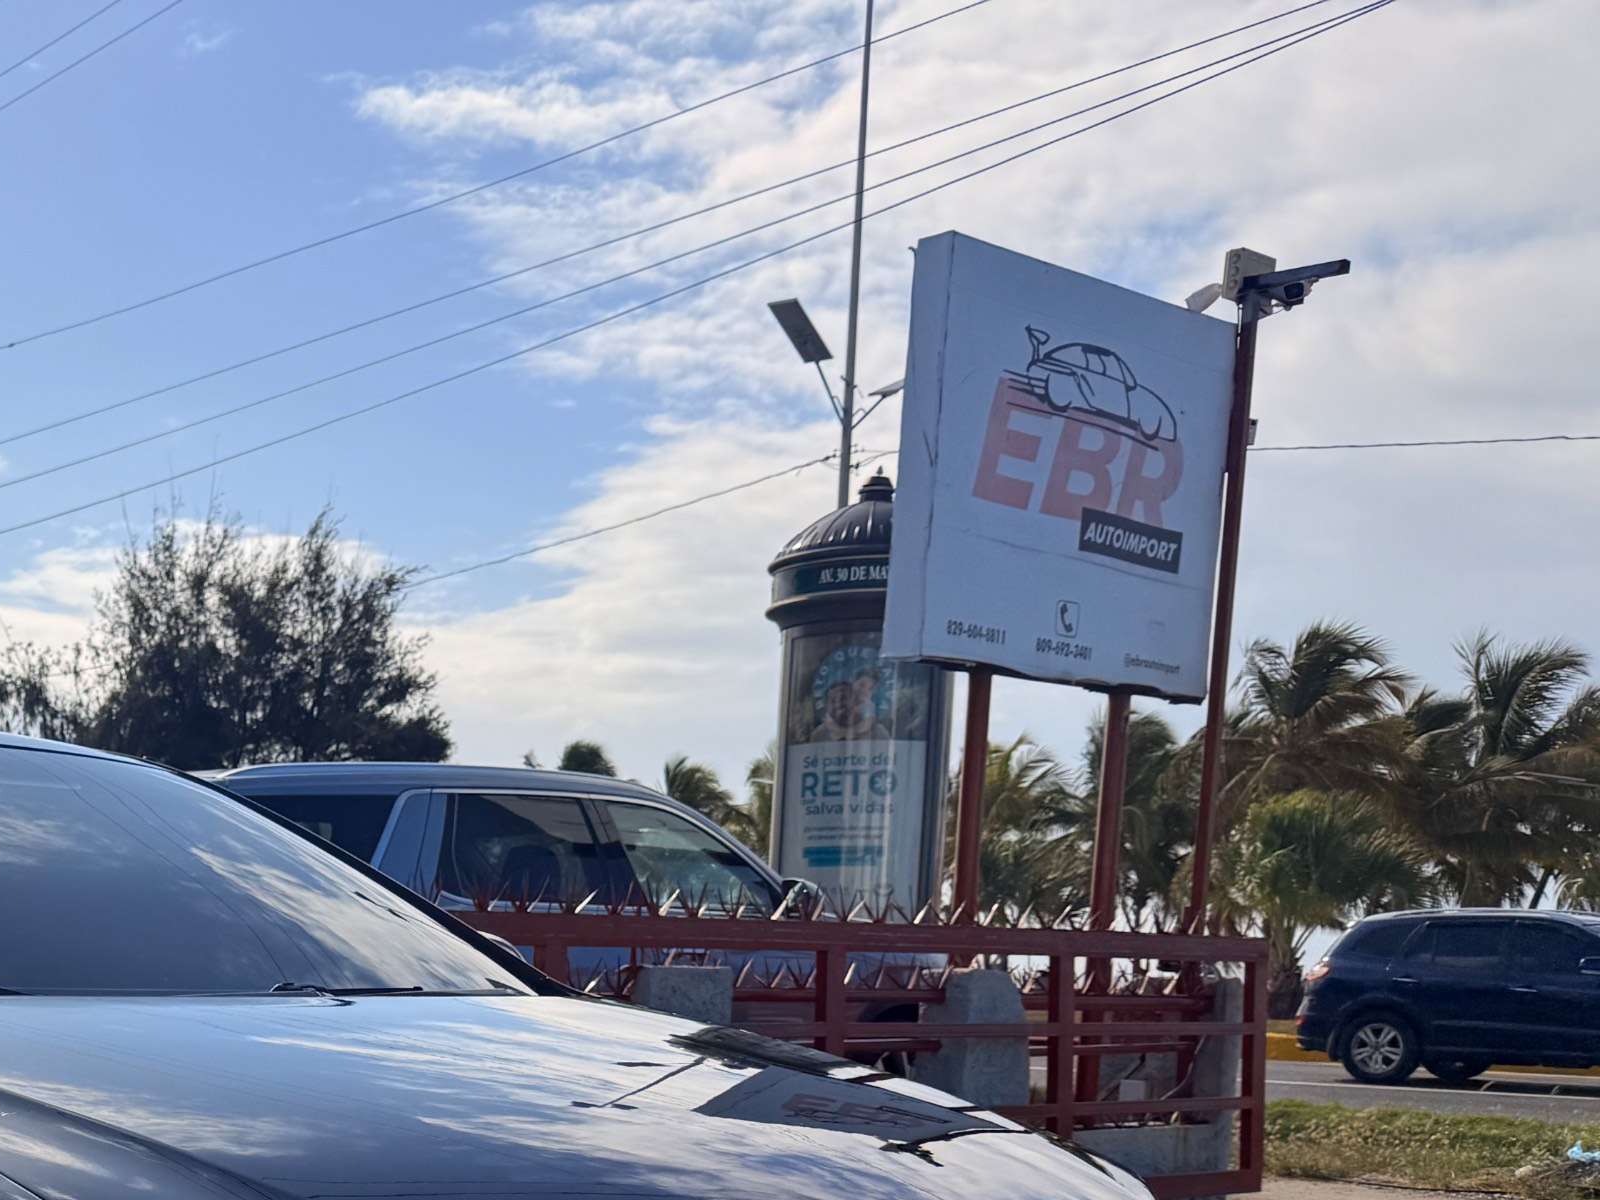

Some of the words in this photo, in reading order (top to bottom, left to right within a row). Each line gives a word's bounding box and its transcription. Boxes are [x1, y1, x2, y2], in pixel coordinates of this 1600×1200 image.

[971, 376, 1185, 528] EBR
[1083, 520, 1179, 562] AUTOIMPORT
[850, 565, 868, 580] DE
[869, 566, 889, 580] MA
[823, 754, 866, 769] parte
[801, 769, 898, 798] RETO
[805, 802, 844, 816] salva
